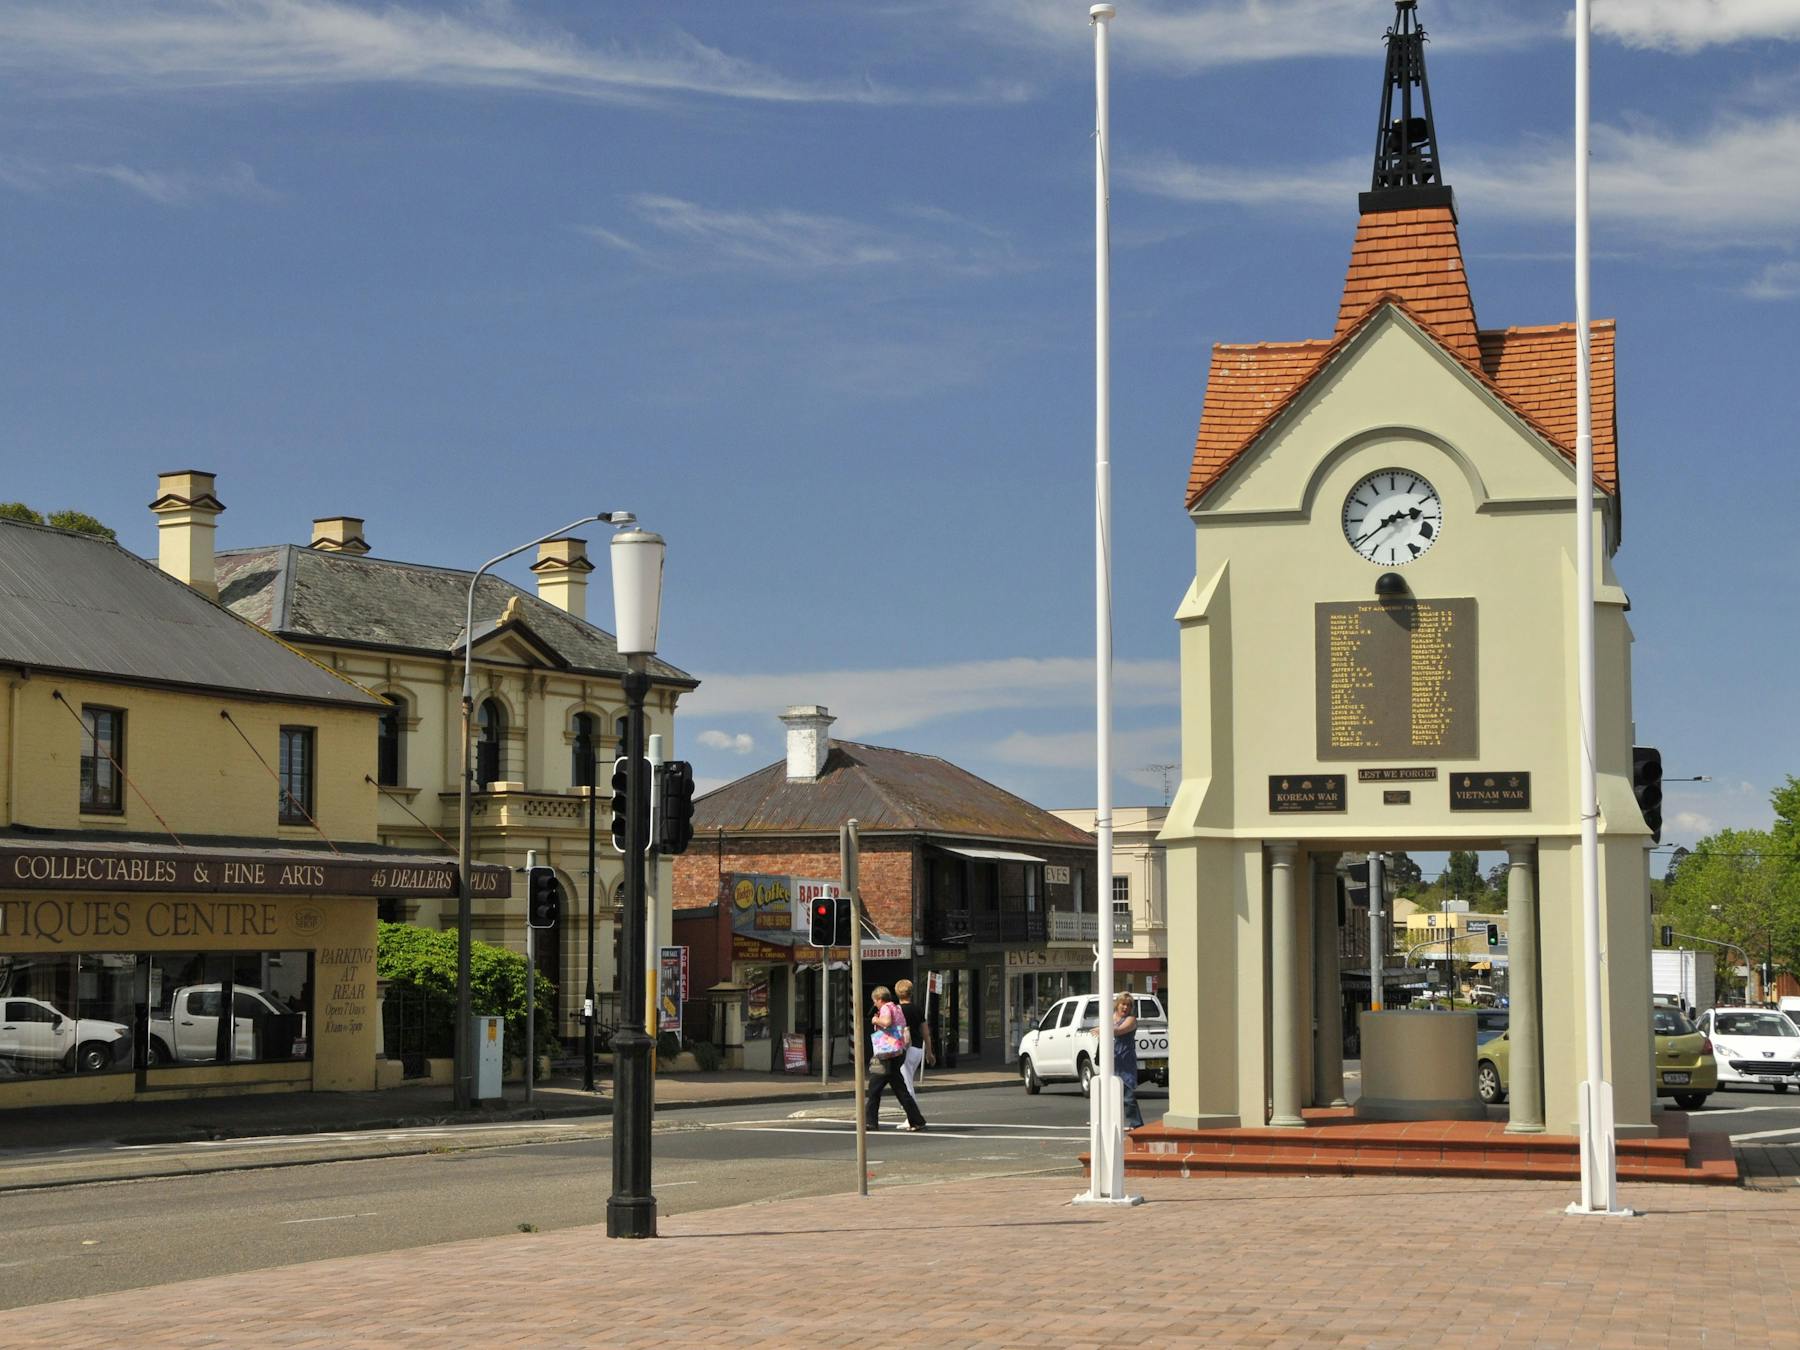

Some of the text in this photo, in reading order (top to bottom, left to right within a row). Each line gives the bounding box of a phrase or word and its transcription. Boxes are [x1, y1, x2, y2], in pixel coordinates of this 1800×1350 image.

[1359, 769, 1436, 779] LEST WE FORGET
[1277, 792, 1338, 802] KOREAN WAR
[1456, 790, 1524, 799] VIETNAM WAR
[14, 855, 324, 887] COLLECTABLES & FINE ARTS
[371, 868, 498, 890] 45 DEALERS PLUS
[146, 902, 279, 937] CENTRE
[320, 948, 374, 965] PARKING
[863, 948, 902, 957] BARBER SHOP
[341, 965, 359, 982] AT
[333, 984, 365, 1000] REAR
